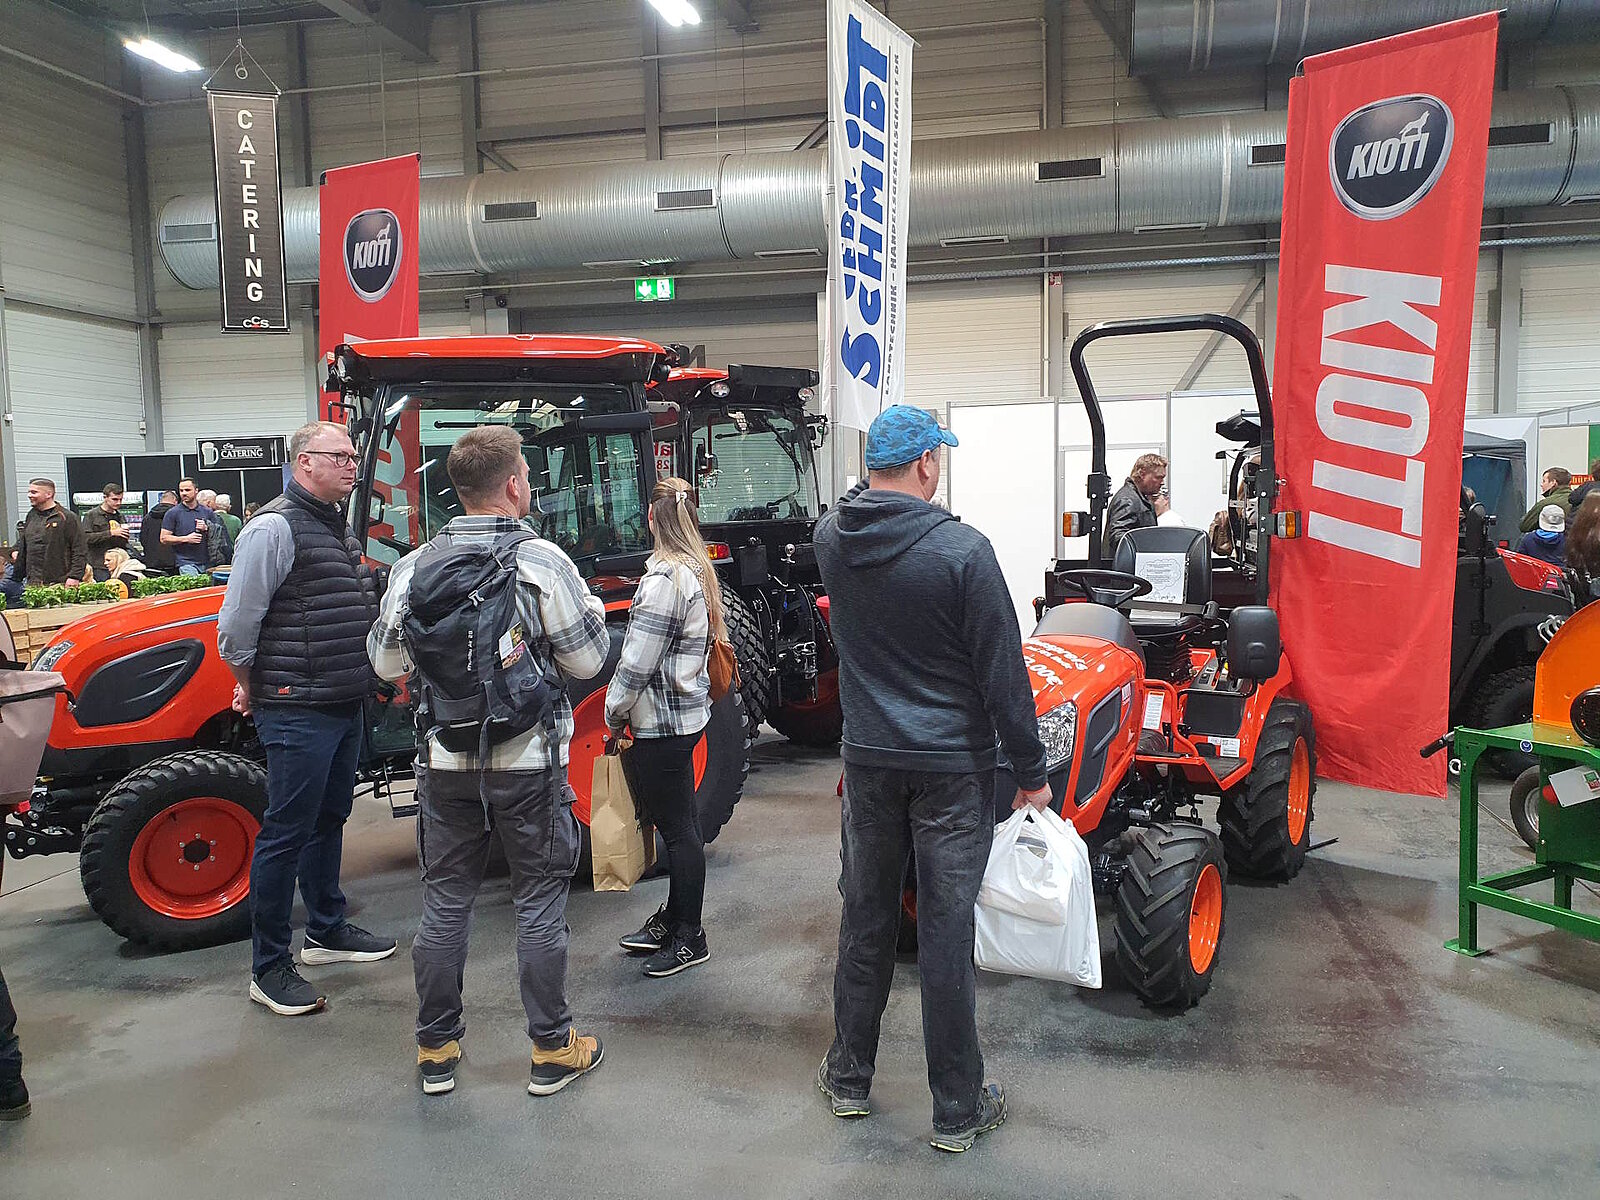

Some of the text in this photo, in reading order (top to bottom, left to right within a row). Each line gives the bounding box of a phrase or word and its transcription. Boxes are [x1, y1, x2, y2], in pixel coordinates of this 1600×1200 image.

[1346, 131, 1430, 181] KIOTI
[237, 109, 264, 303] CATERING
[352, 237, 392, 270] KIOTI
[884, 285, 897, 395] LANDTECHNIK
[1307, 263, 1443, 569] KIOTI
[220, 448, 264, 458] CATERING
[675, 946, 694, 964] N
